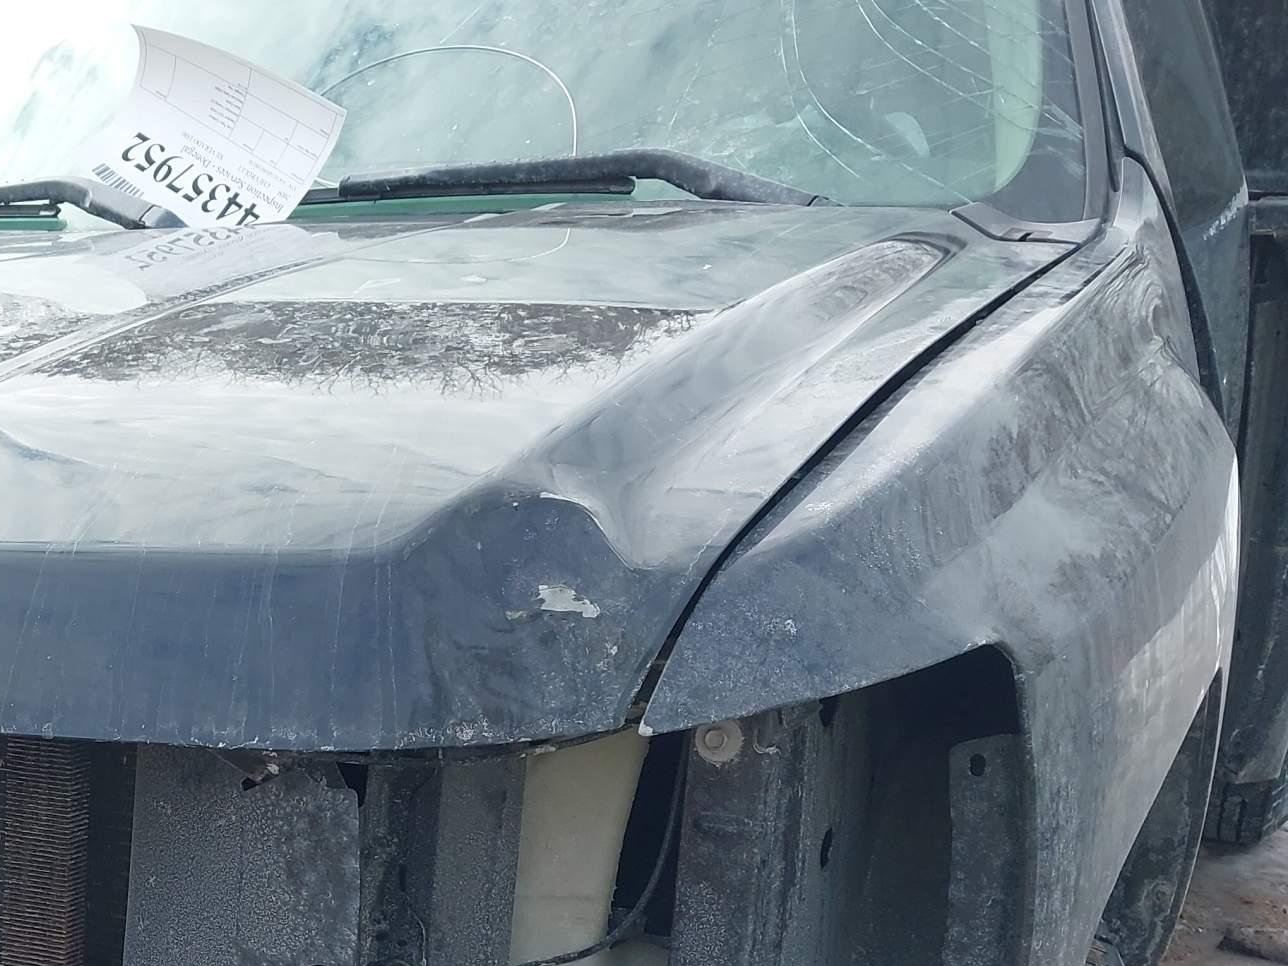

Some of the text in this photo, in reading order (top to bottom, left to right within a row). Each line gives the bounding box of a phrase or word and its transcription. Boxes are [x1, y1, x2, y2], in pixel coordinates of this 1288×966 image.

[121, 132, 260, 227] 44357952
[215, 167, 246, 190] Services
[244, 183, 284, 213] Inspection
